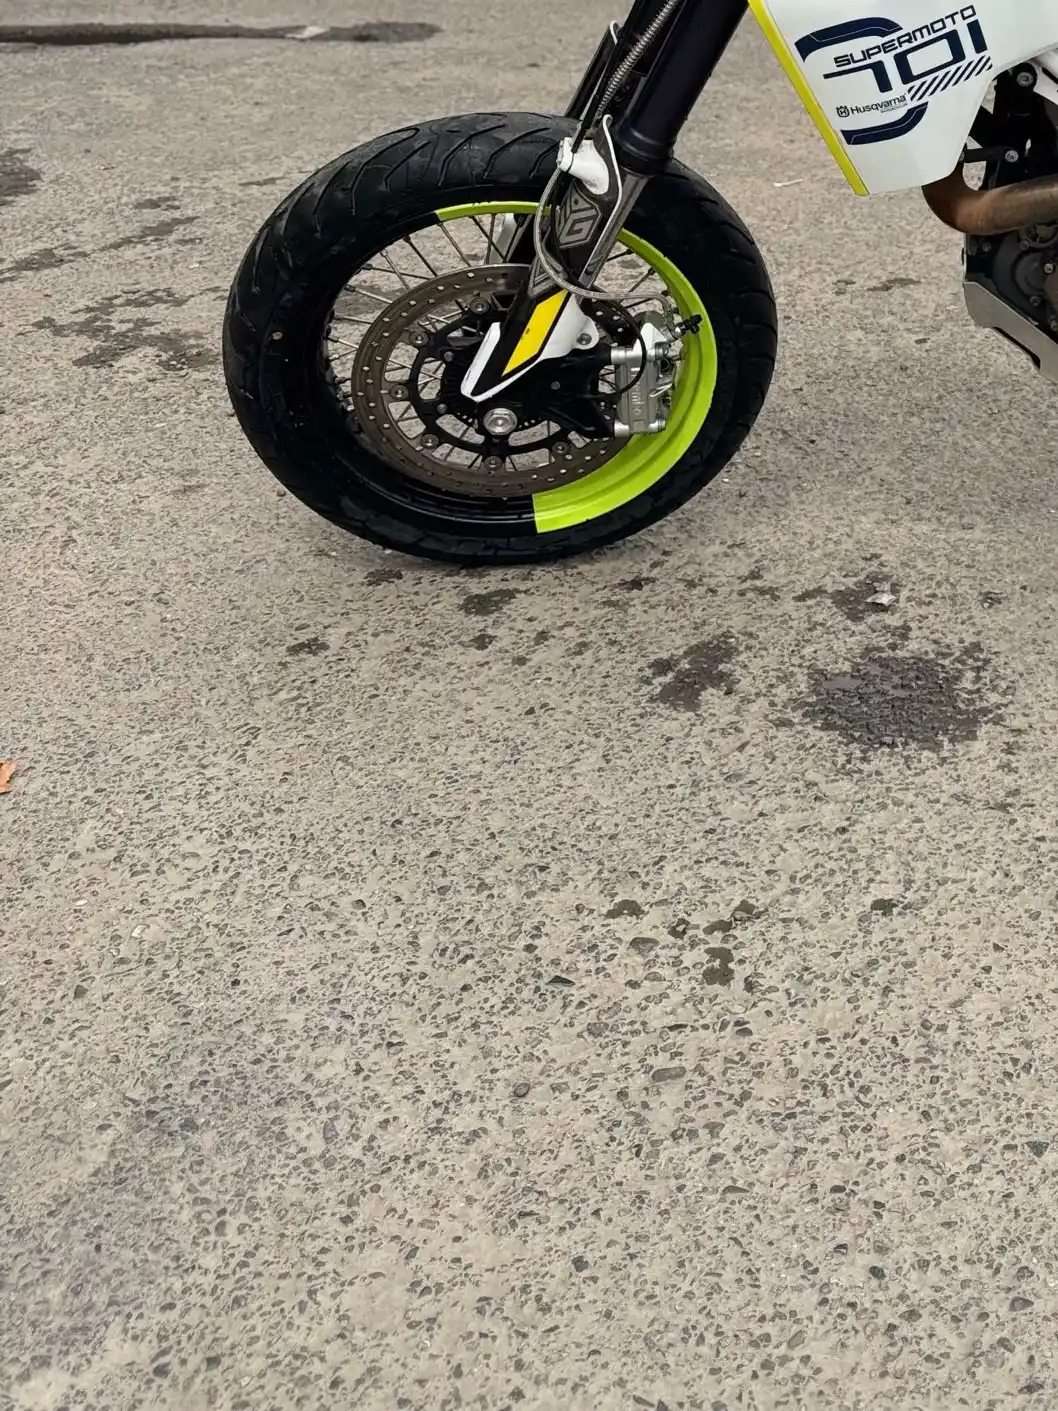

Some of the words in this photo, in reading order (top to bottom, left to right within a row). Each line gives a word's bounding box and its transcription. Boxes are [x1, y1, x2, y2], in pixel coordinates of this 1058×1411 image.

[823, 19, 988, 93] 701
[834, 4, 976, 68] SUPERMOTO
[850, 94, 906, 114] Husqvarna
